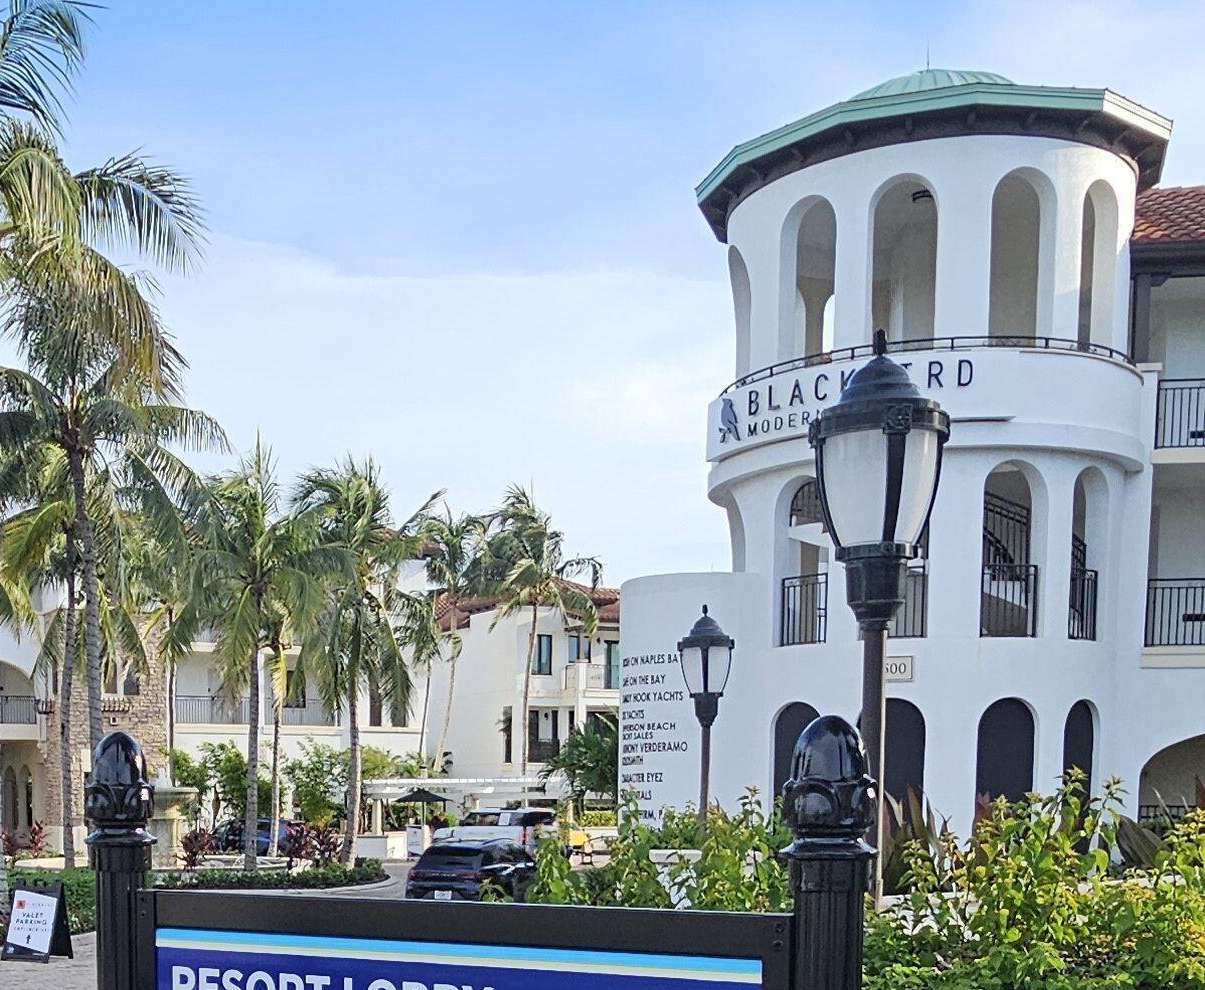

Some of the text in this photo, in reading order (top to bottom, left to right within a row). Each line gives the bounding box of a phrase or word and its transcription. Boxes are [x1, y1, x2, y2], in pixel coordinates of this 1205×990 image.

[748, 359, 974, 417] BLACKRD
[640, 653, 665, 665] NAPLES
[651, 674, 666, 685] BAY
[653, 691, 683, 702] YACHTS
[647, 722, 676, 731] BEACH
[634, 731, 654, 740] SALES
[640, 741, 688, 753] VERDERAMO
[646, 772, 663, 783] EYEZ
[15, 918, 48, 926] PARKING
